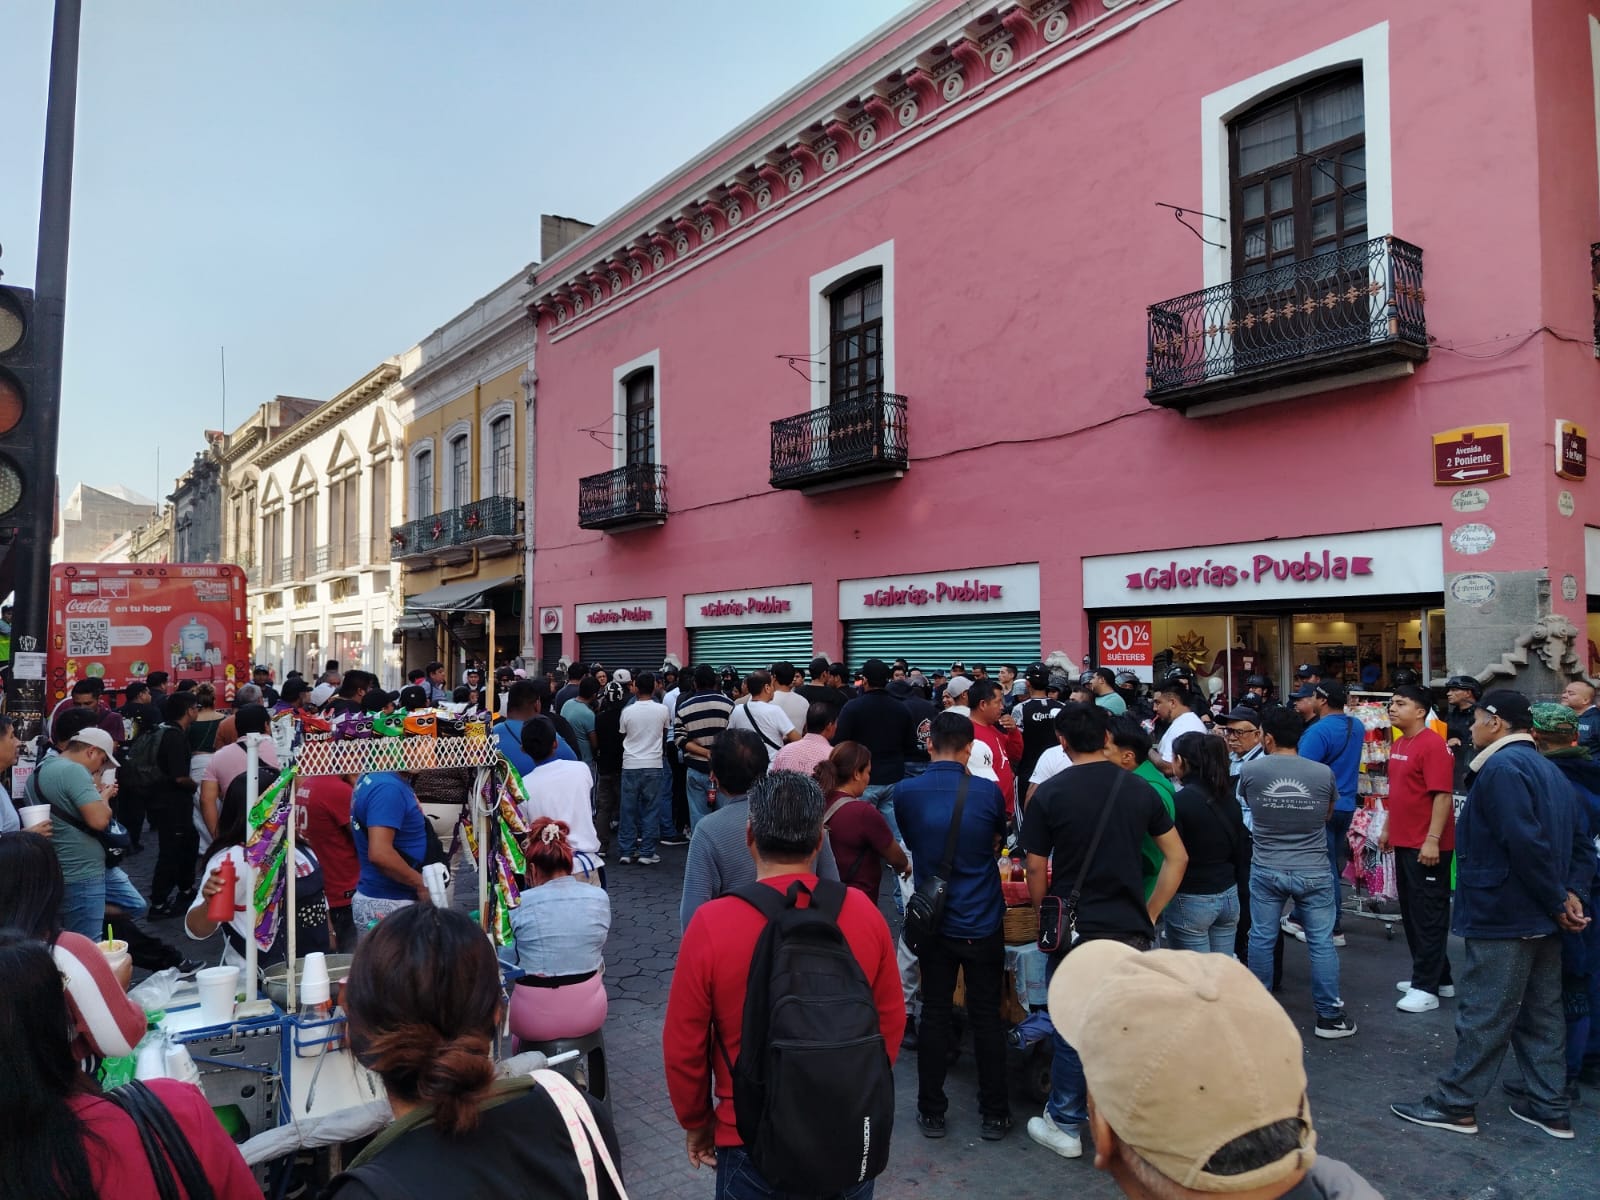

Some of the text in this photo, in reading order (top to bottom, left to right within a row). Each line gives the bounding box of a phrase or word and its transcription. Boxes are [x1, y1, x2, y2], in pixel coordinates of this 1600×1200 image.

[1455, 445, 1482, 456] Avenida
[1446, 453, 1492, 467] 2 Poniente
[1143, 550, 1348, 591] Galerías Puebla
[873, 579, 989, 607] Galerías Puebla
[115, 605, 127, 613] en
[130, 604, 141, 613] tu
[143, 603, 172, 614] hogar
[621, 606, 646, 622] Puebla
[707, 596, 782, 617] Galerías Puebla
[1102, 624, 1150, 651] 30%
[1107, 651, 1146, 661] SUÉTERES
